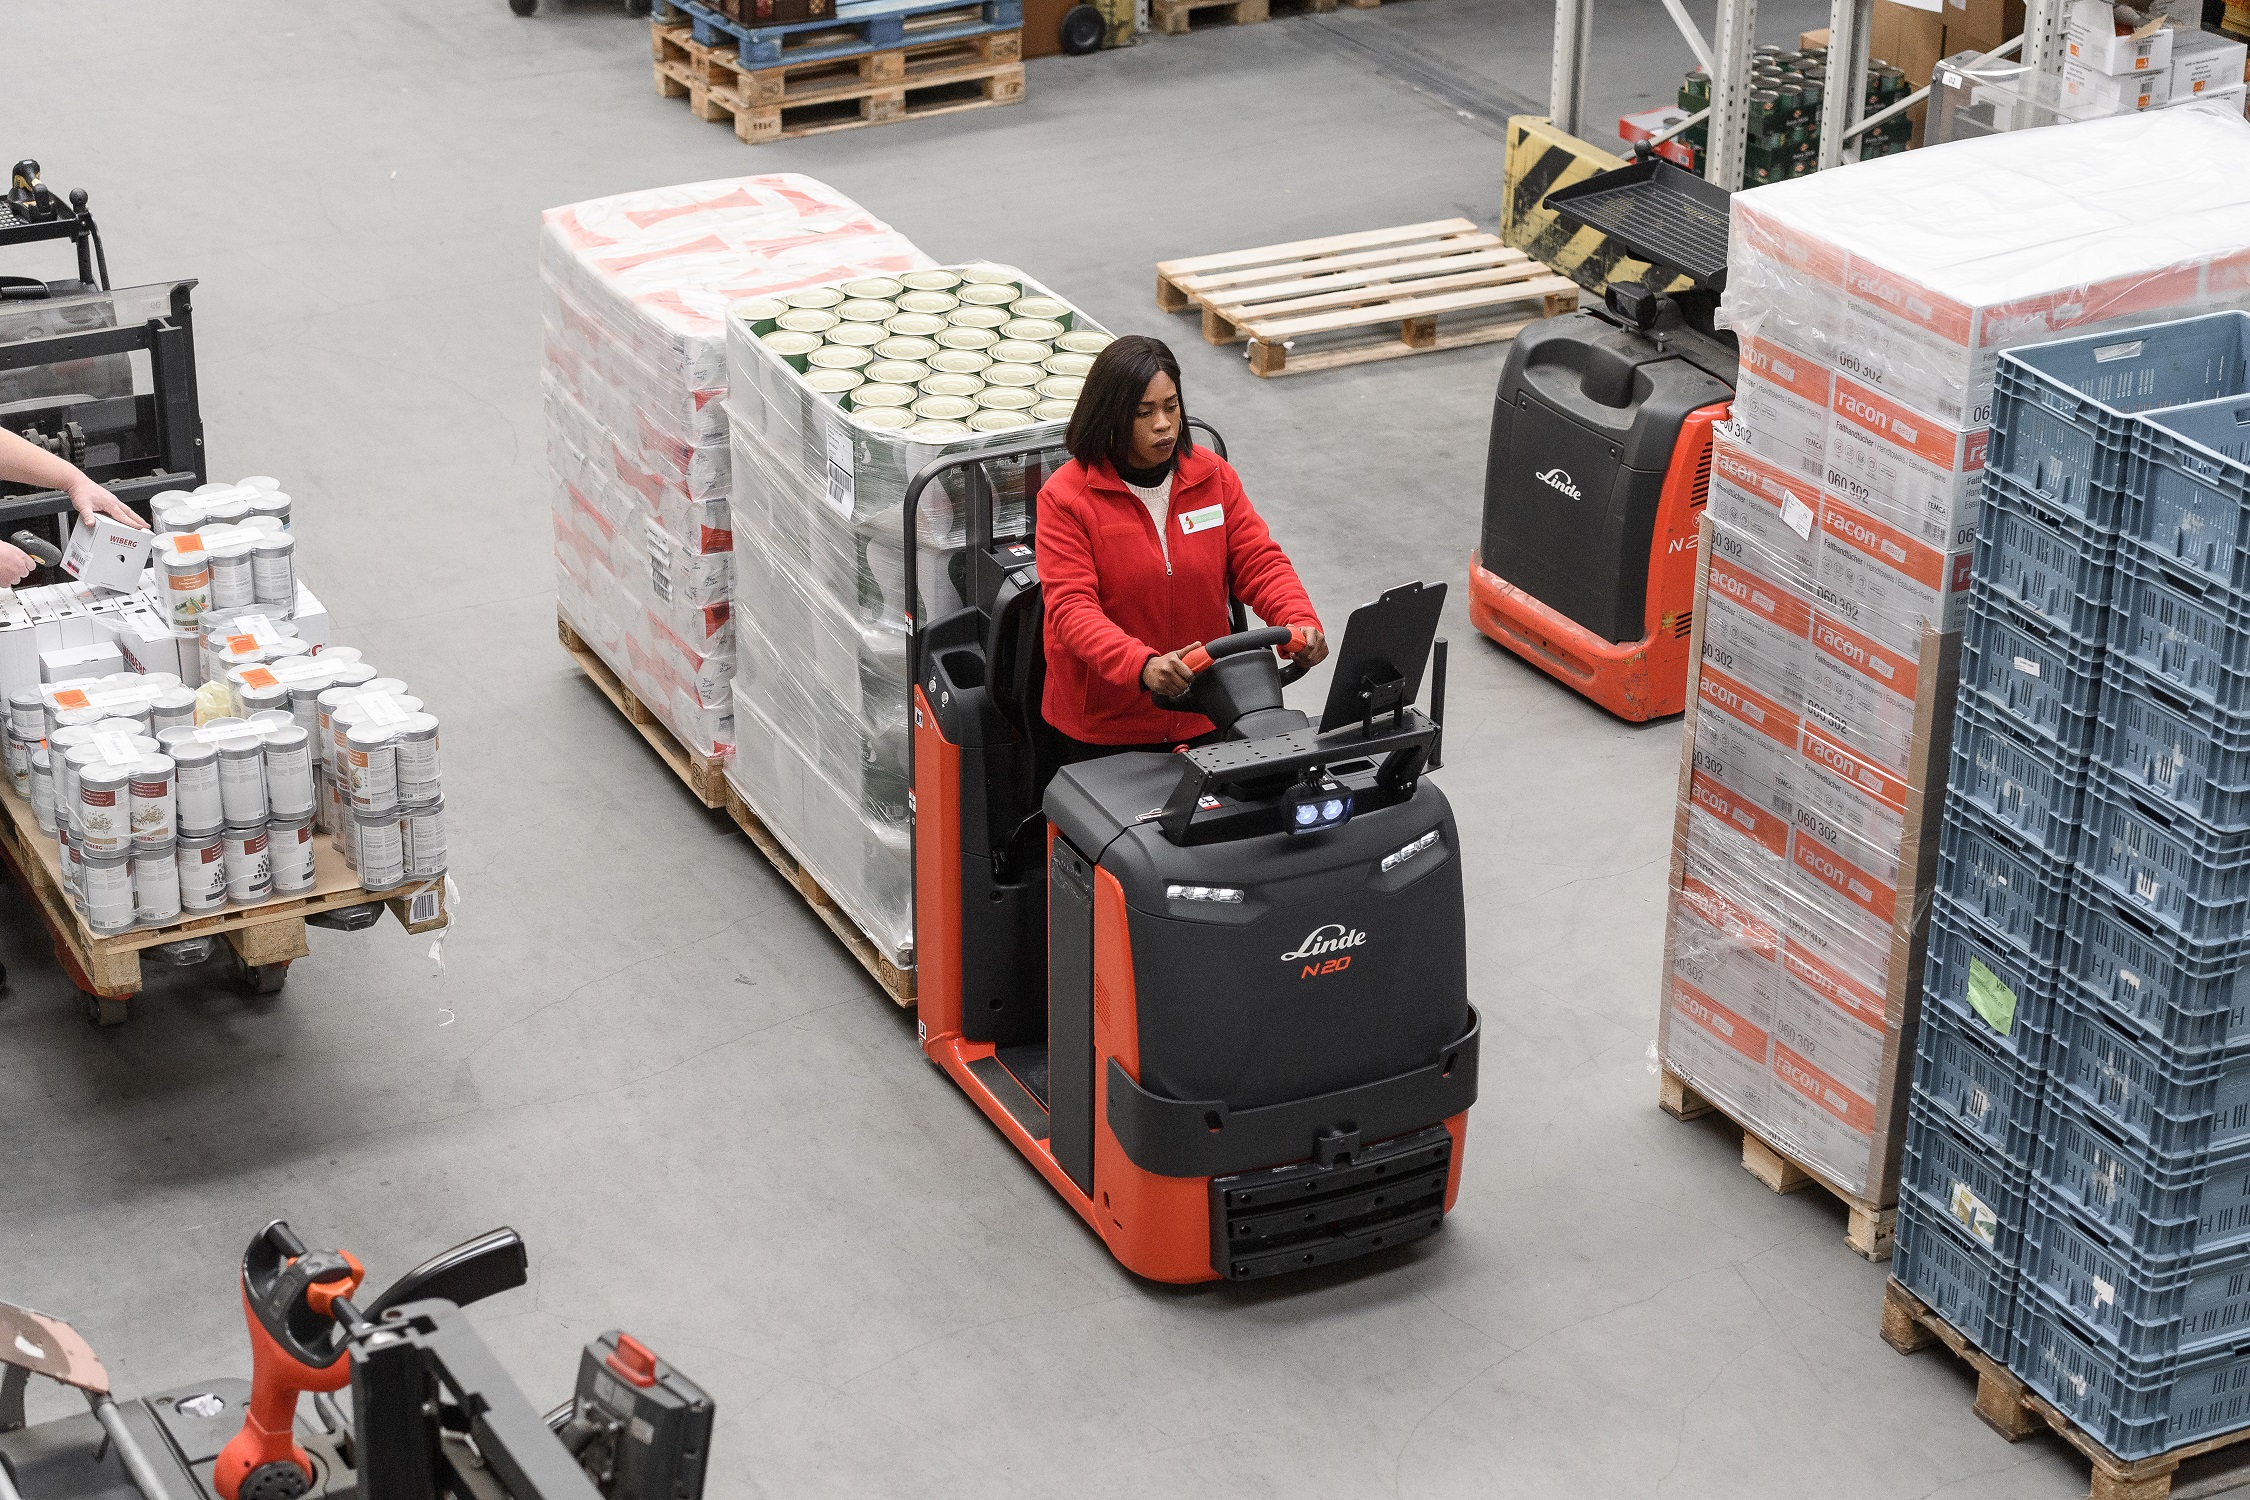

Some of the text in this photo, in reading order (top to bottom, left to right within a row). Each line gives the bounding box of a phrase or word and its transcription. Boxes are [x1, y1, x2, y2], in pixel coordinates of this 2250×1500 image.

[1742, 342, 1767, 370] con
[1839, 351, 1861, 372] 060
[1838, 391, 1887, 429] racon
[1973, 405, 1991, 422] 06
[1734, 423, 1752, 445] 302
[1535, 468, 1583, 501] Linde
[1714, 452, 1758, 487] racon
[1828, 469, 1869, 505] 060 302
[109, 535, 139, 548] WIBERG
[1712, 532, 1743, 558] 60 302
[1826, 510, 1877, 548] racon
[1957, 527, 1975, 545] 06
[1709, 567, 1748, 599] acon
[1817, 586, 1860, 622] 060 302
[1702, 641, 1733, 670] 60 302
[1816, 624, 1865, 664] racon
[1700, 676, 1738, 709] acon
[1828, 712, 1848, 736] 302
[1692, 750, 1723, 777] 60 302
[1807, 736, 1855, 777] racon
[1691, 782, 1729, 815] acon
[1797, 809, 1838, 845] 060 302
[1798, 844, 1845, 885] racon
[1280, 924, 1367, 962] Linde
[1686, 962, 1704, 984] 302
[1674, 988, 1709, 1021] acon
[1777, 1019, 1817, 1057] 060 302
[1776, 1055, 1821, 1095] racon
